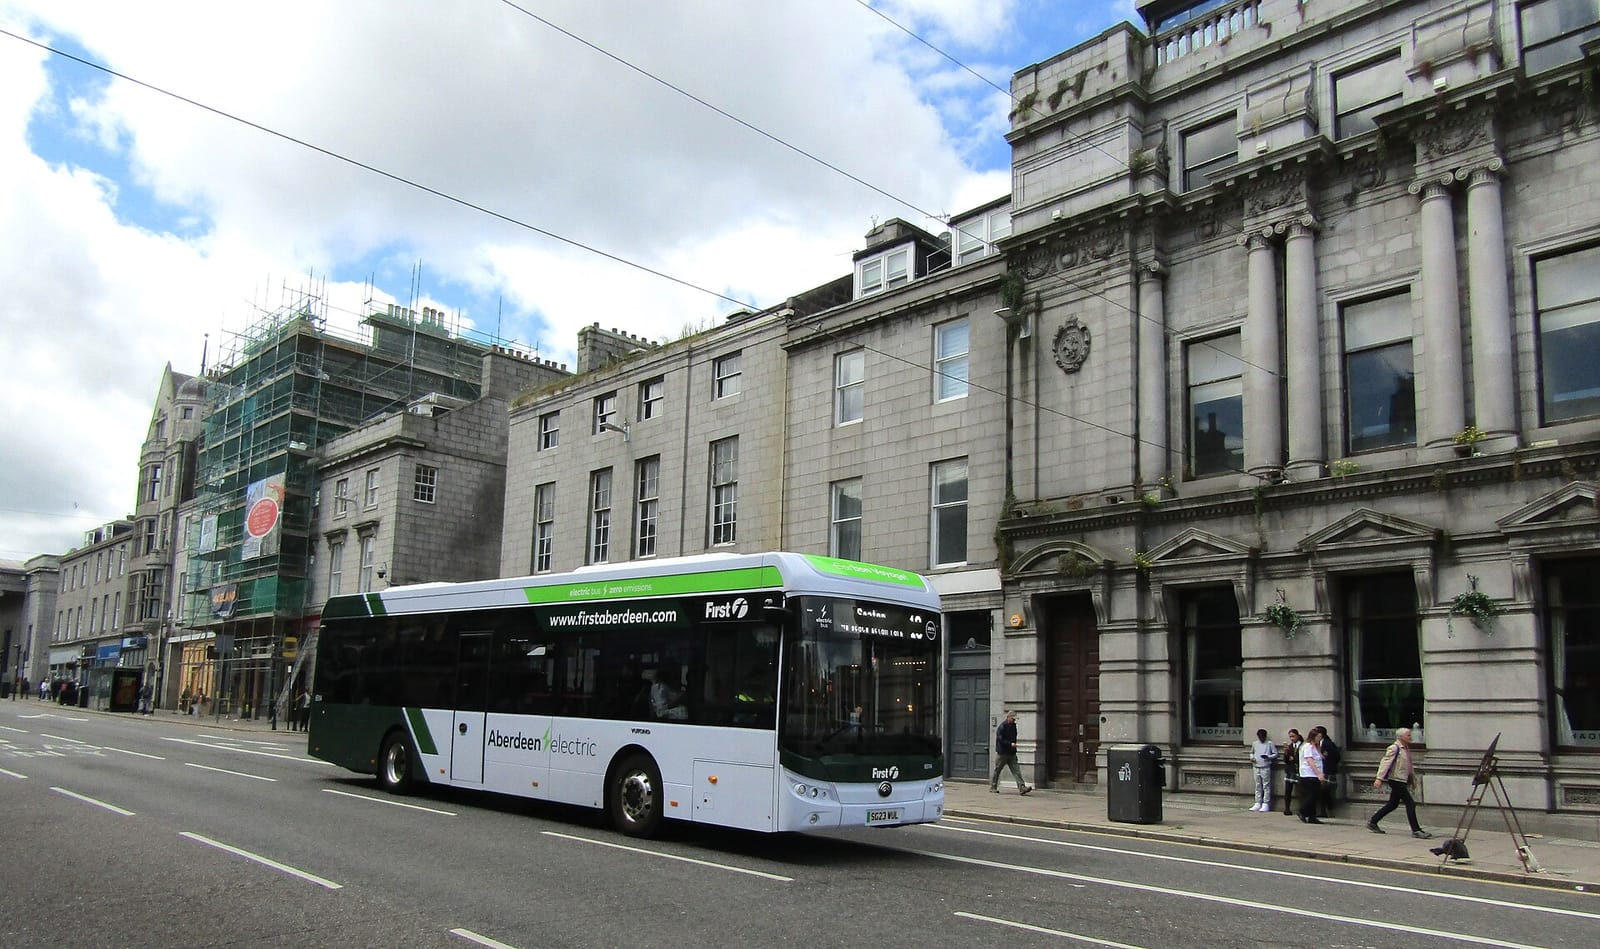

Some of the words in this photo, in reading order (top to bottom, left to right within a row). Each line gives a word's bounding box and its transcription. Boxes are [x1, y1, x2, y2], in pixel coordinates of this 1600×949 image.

[569, 587, 590, 597] electric
[591, 587, 601, 595] bus
[609, 586, 622, 594] zero
[624, 584, 652, 593] emissions
[549, 607, 677, 627] www.firstaberdeen.com
[705, 601, 730, 618] First
[487, 729, 541, 751] Aberdeen
[551, 734, 597, 757] electric
[872, 767, 889, 779] First
